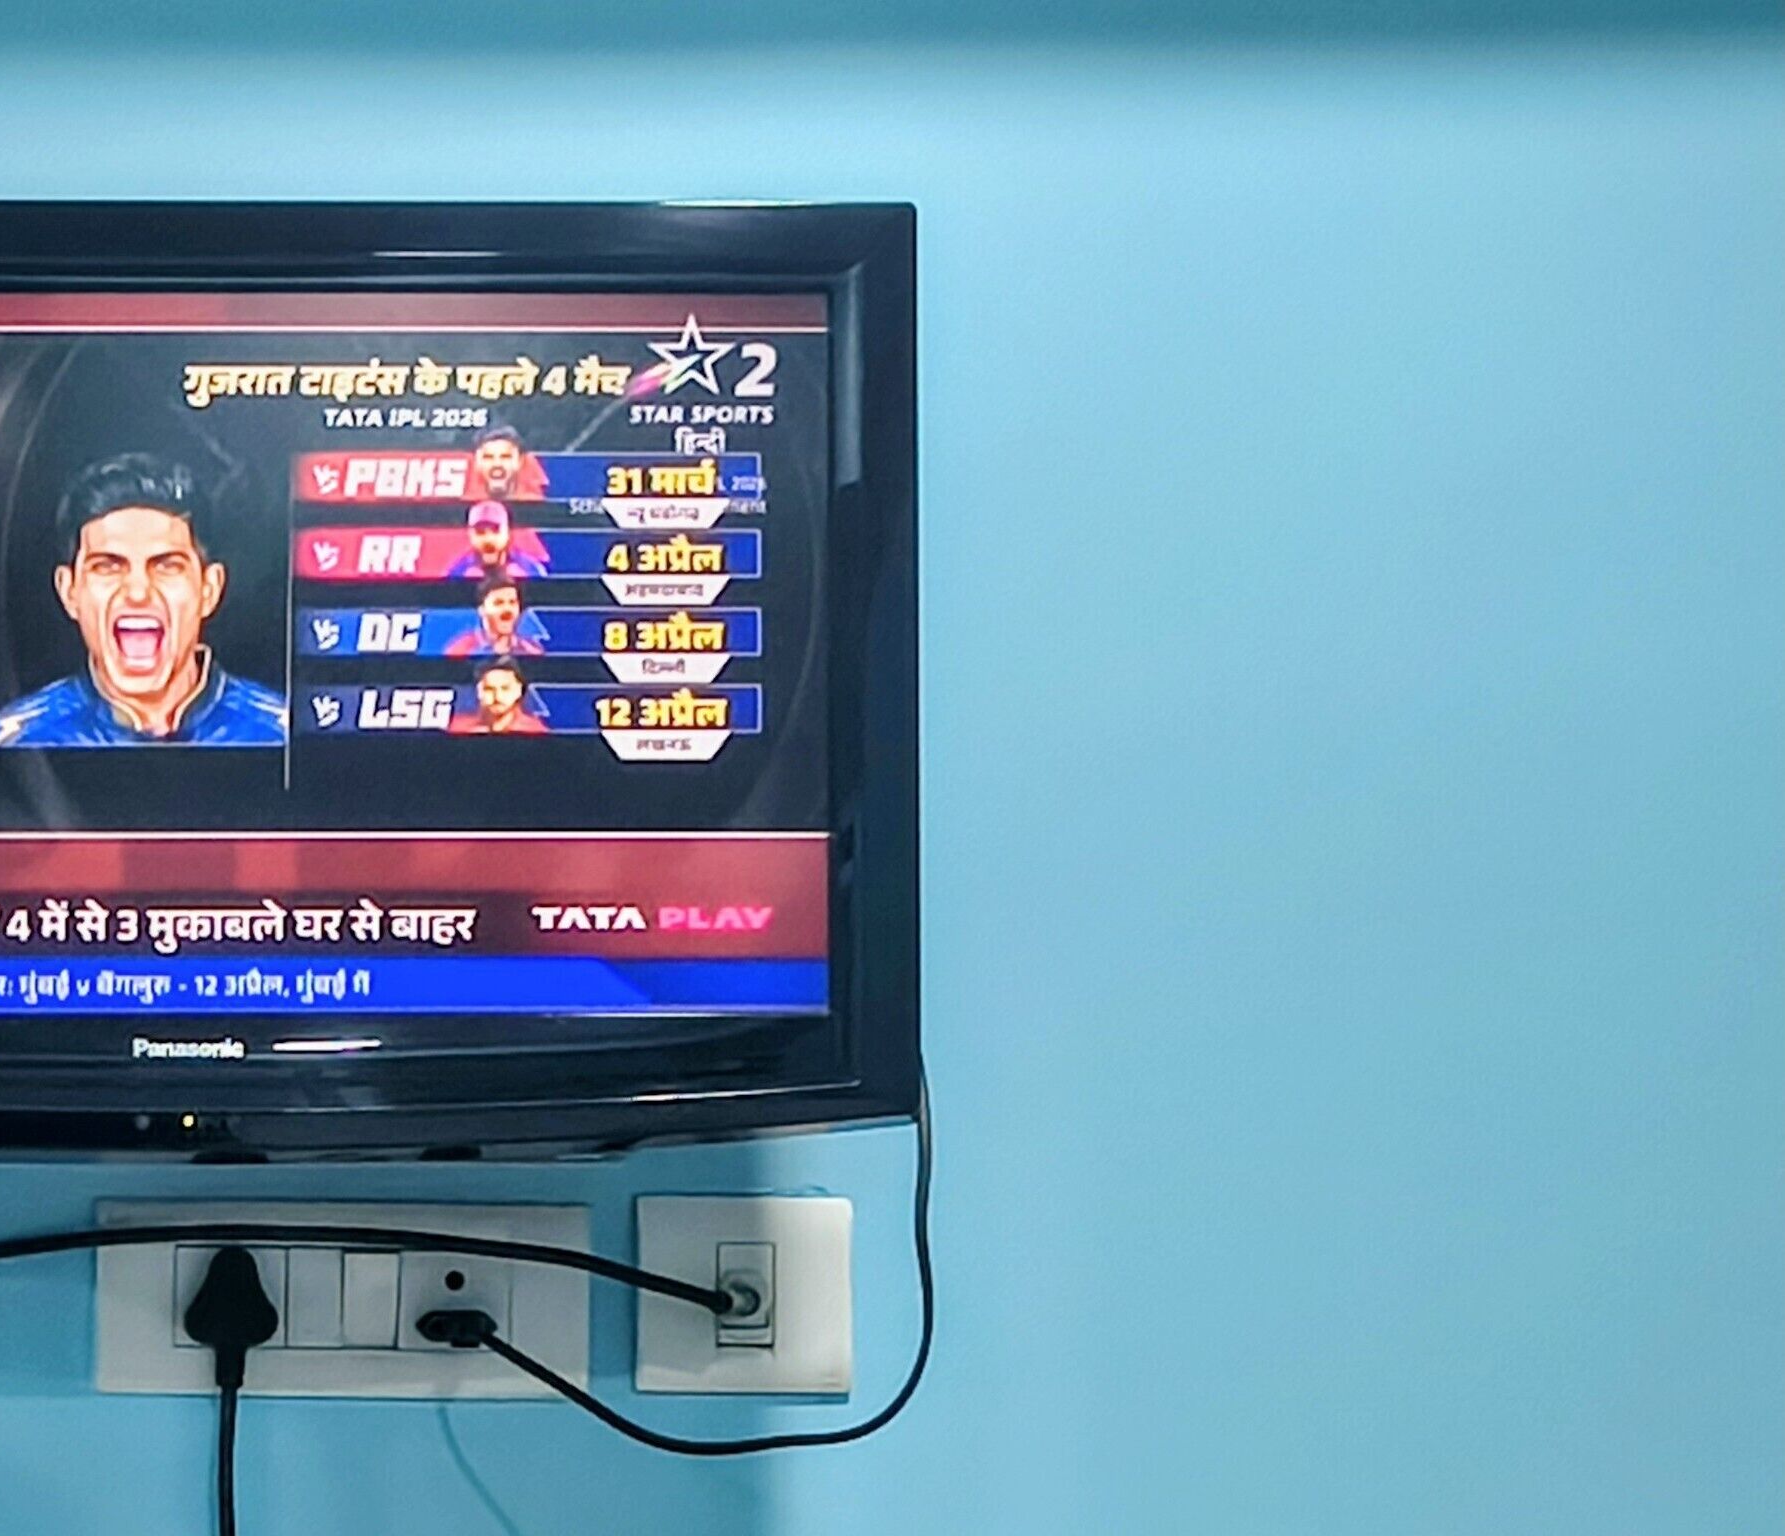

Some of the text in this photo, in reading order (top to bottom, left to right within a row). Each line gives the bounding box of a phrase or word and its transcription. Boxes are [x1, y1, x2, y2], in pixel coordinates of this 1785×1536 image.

[183, 355, 632, 408] गुजरात टाइटंस के पहले 4 मैच
[733, 342, 778, 397] 2
[324, 407, 490, 428] TATA IPL 2026
[629, 404, 774, 424] STAR SPORTS
[674, 426, 726, 456] हिन्दी
[343, 458, 469, 498] PBKS
[606, 466, 643, 495] 31
[648, 458, 717, 495] मार्च
[358, 534, 422, 574] RR
[606, 533, 725, 573] 4 अप्रैल
[357, 613, 423, 651] DC
[604, 611, 726, 651] 8 अप्रैल
[358, 689, 455, 730] LSG
[595, 687, 728, 727] 12 अप्रैल
[6, 909, 31, 942] 4
[38, 898, 70, 942] में
[74, 898, 110, 942] से
[116, 909, 139, 942] 3
[146, 899, 287, 953] मुकाबले
[292, 909, 345, 942] घर
[349, 898, 384, 942] से
[388, 909, 477, 945] बाहर
[531, 906, 773, 930] TATA PLAY
[195, 975, 218, 997] 12
[132, 1037, 245, 1058] Panasonic
